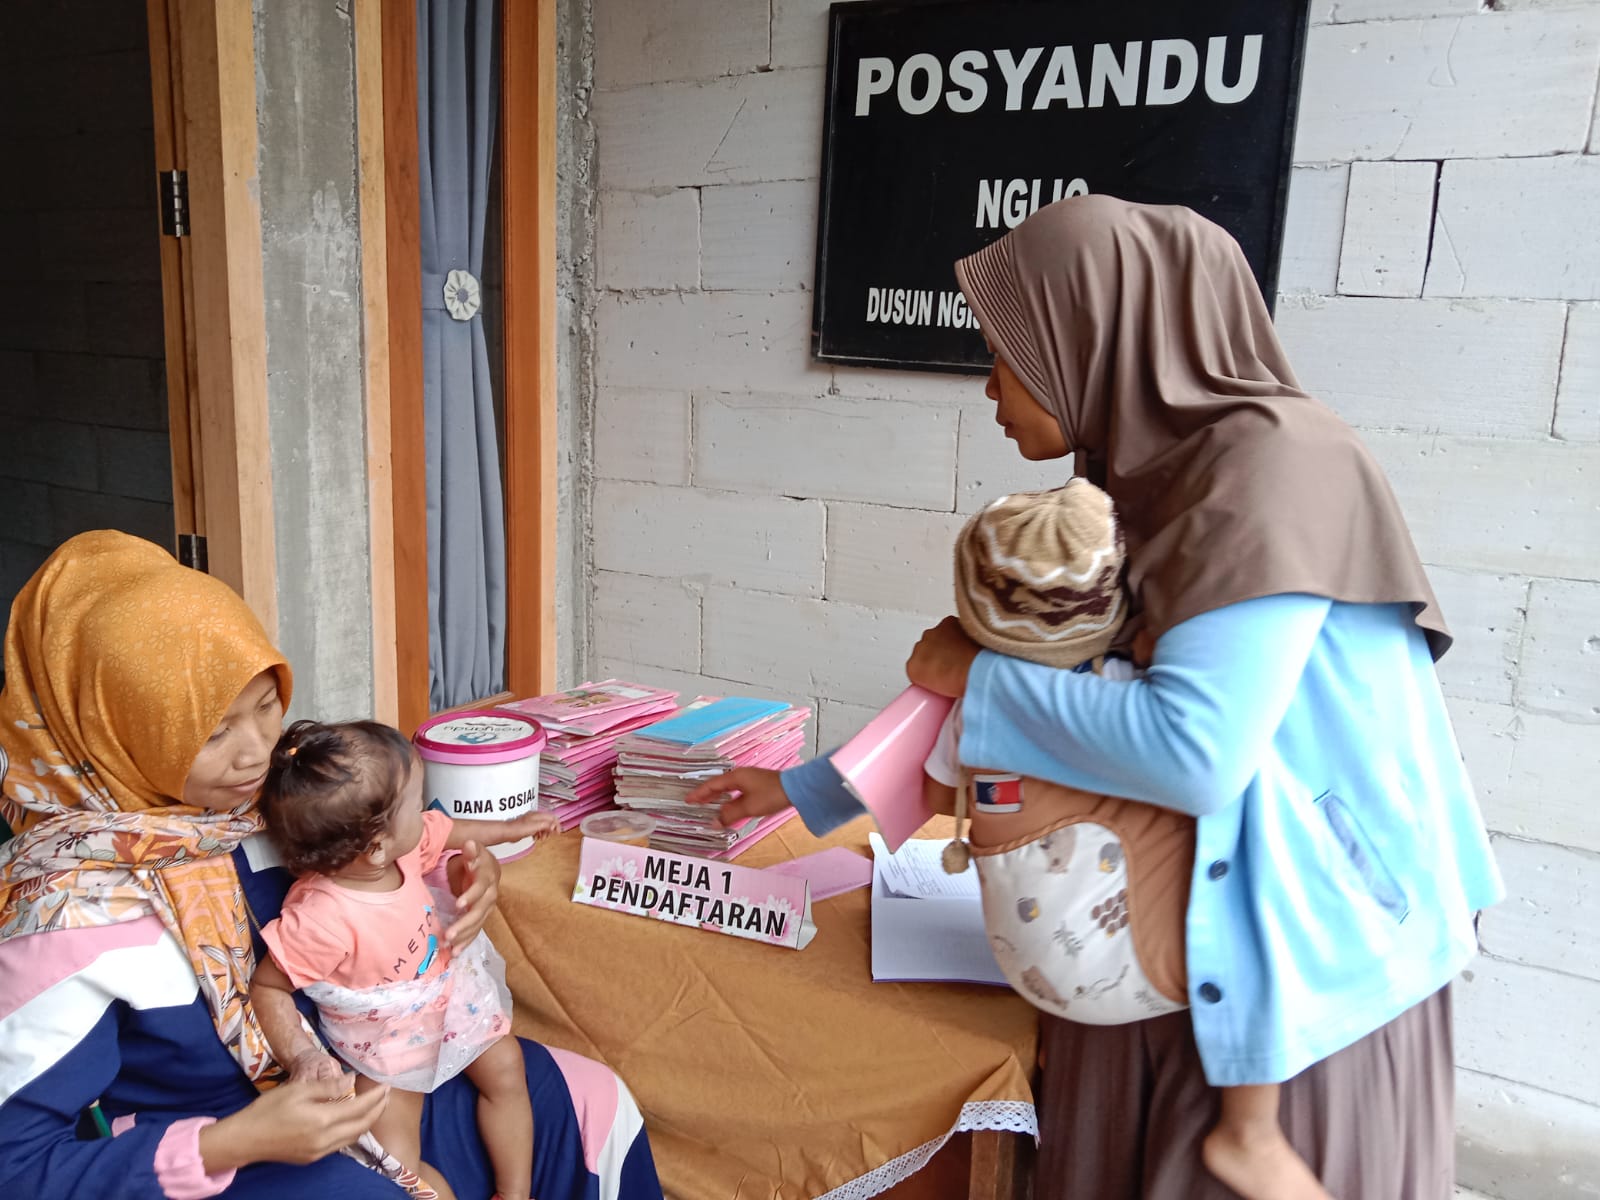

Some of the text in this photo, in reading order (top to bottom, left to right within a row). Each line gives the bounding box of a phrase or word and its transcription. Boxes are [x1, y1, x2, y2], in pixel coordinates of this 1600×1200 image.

[855, 34, 1263, 117] POSYANDU
[866, 287, 933, 326] DUSUN
[454, 787, 535, 814] DANA SOSIAL
[644, 855, 732, 894] MEJA 1
[590, 875, 786, 937] PENDAFTARAN
